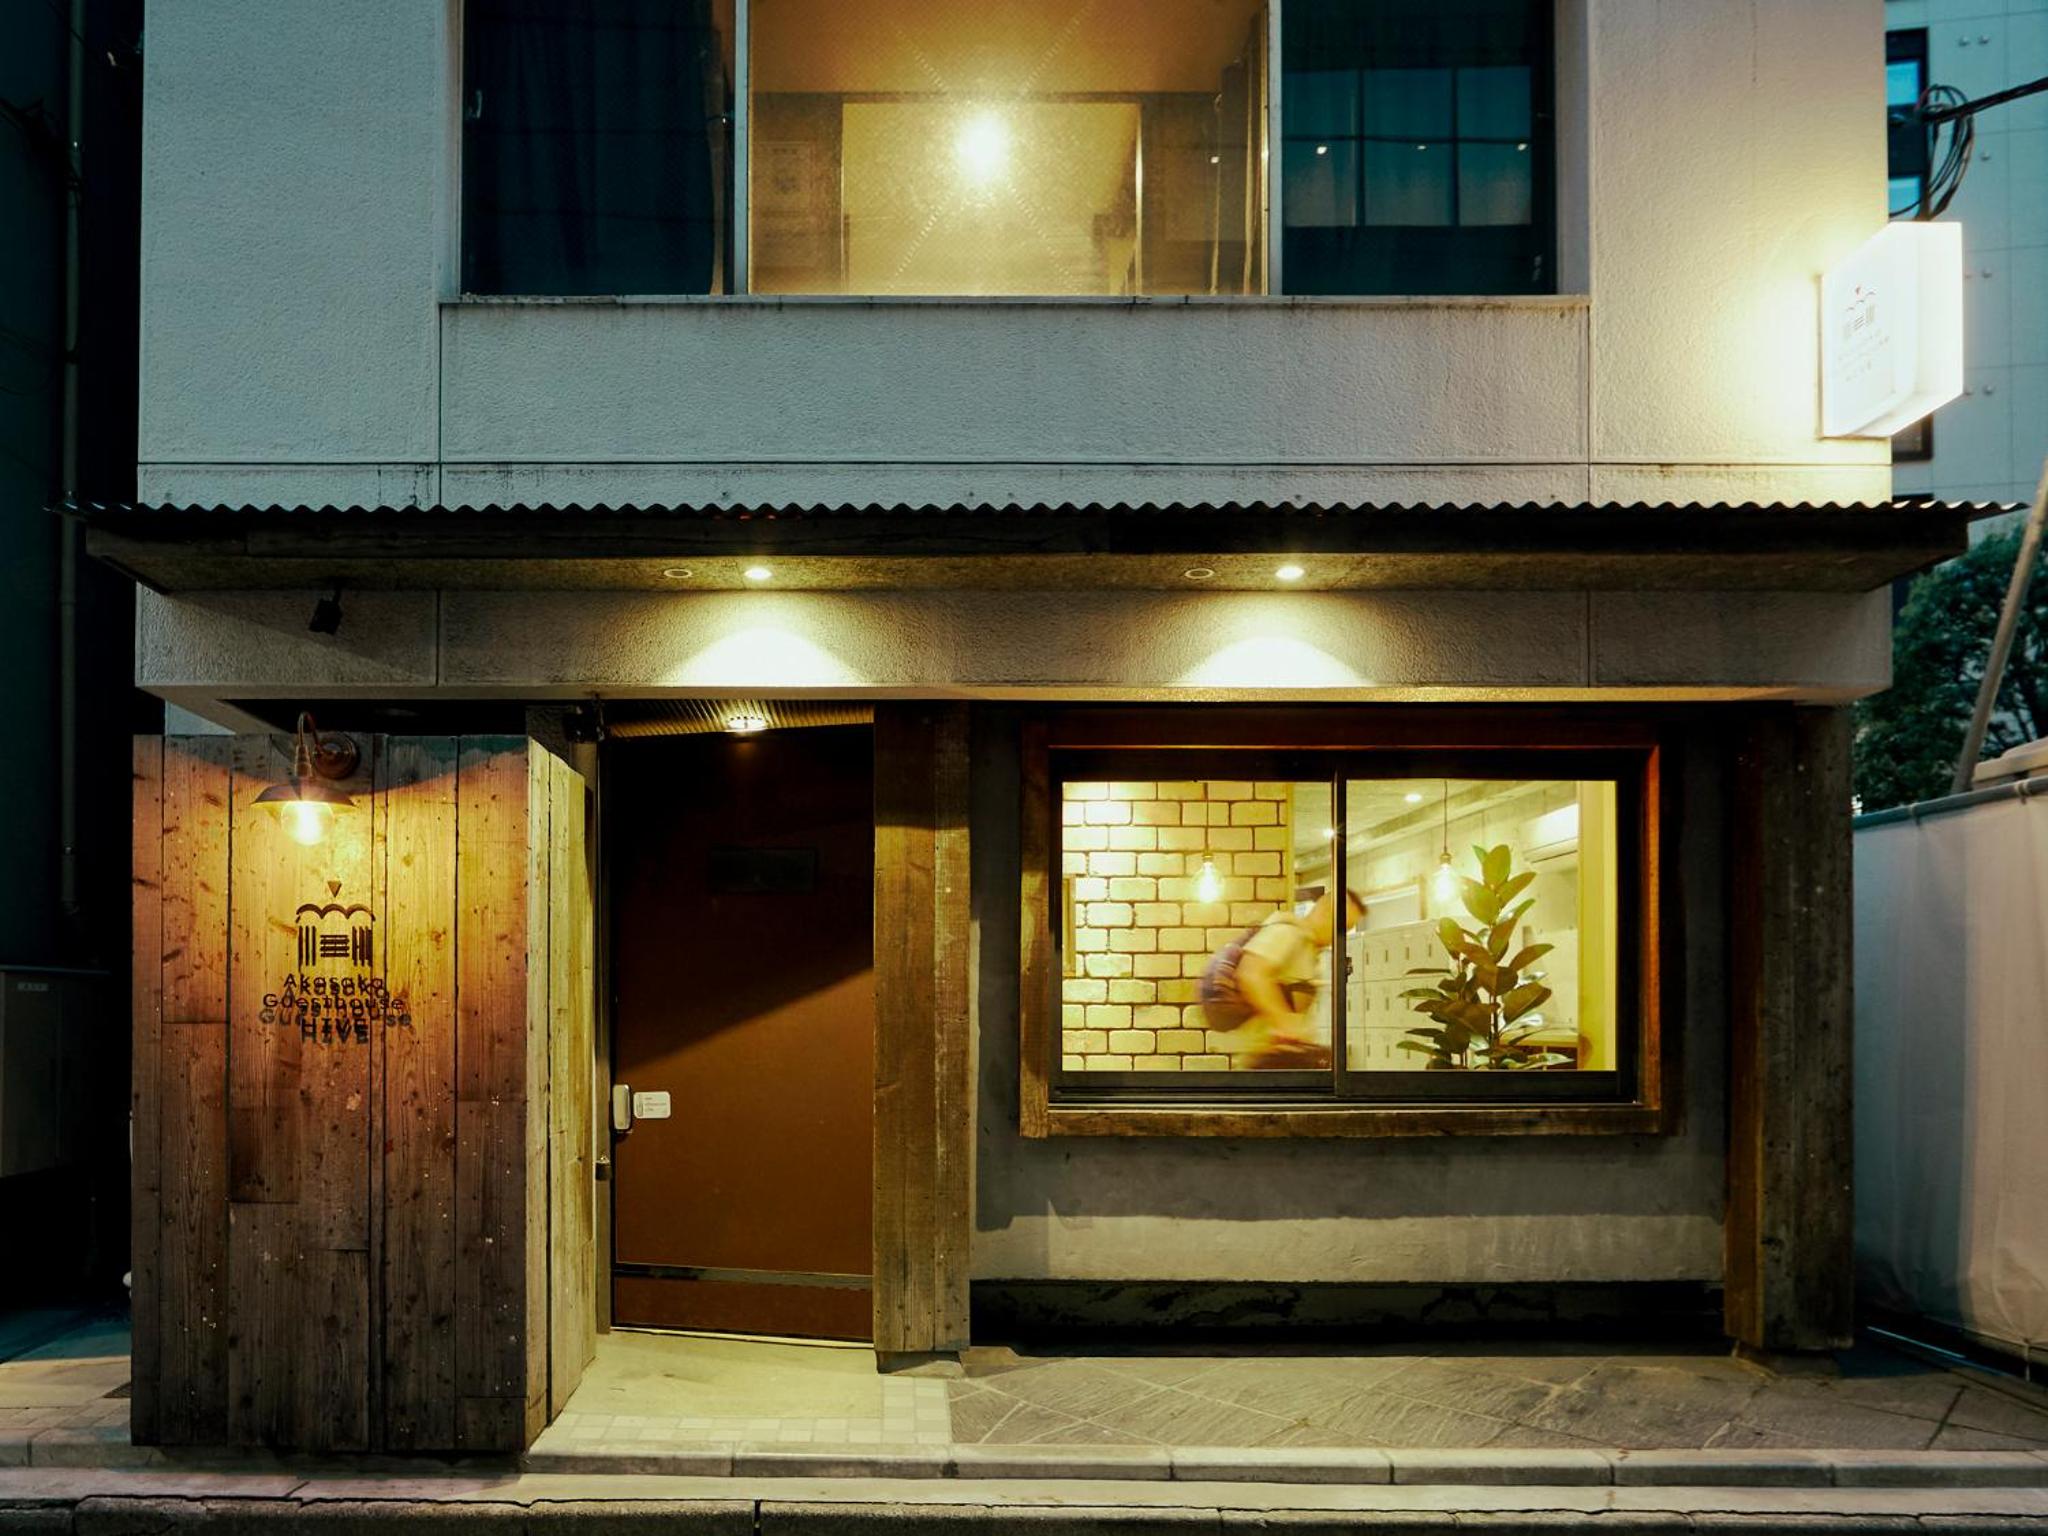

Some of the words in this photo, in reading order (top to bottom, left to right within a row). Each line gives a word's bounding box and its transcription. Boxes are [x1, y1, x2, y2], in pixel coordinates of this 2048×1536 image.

[284, 973, 384, 990] Akasaka
[263, 993, 404, 1010] Guesthouse
[301, 1017, 369, 1037] HIVE
